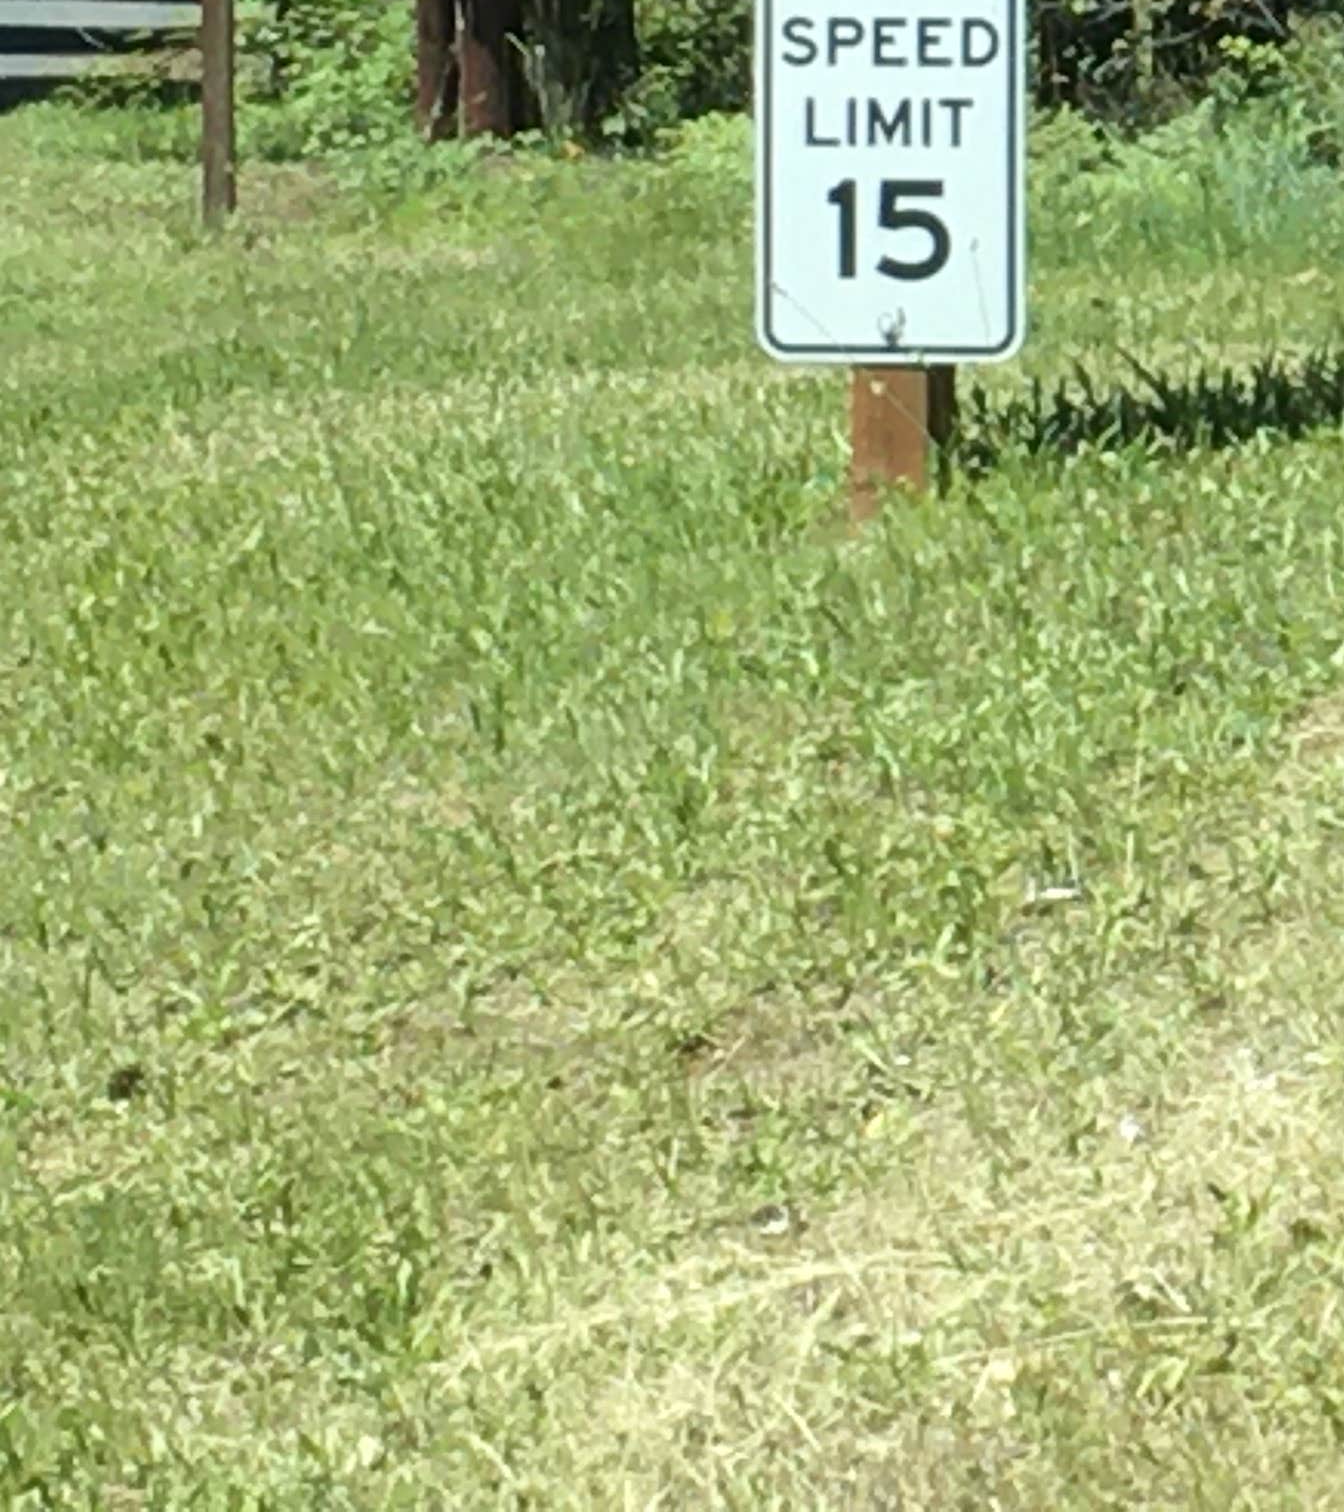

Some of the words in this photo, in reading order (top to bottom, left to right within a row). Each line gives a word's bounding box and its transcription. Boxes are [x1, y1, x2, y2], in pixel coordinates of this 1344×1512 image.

[781, 15, 1000, 68] SPEED
[804, 96, 975, 148] LIMIT
[826, 177, 952, 283] 15
